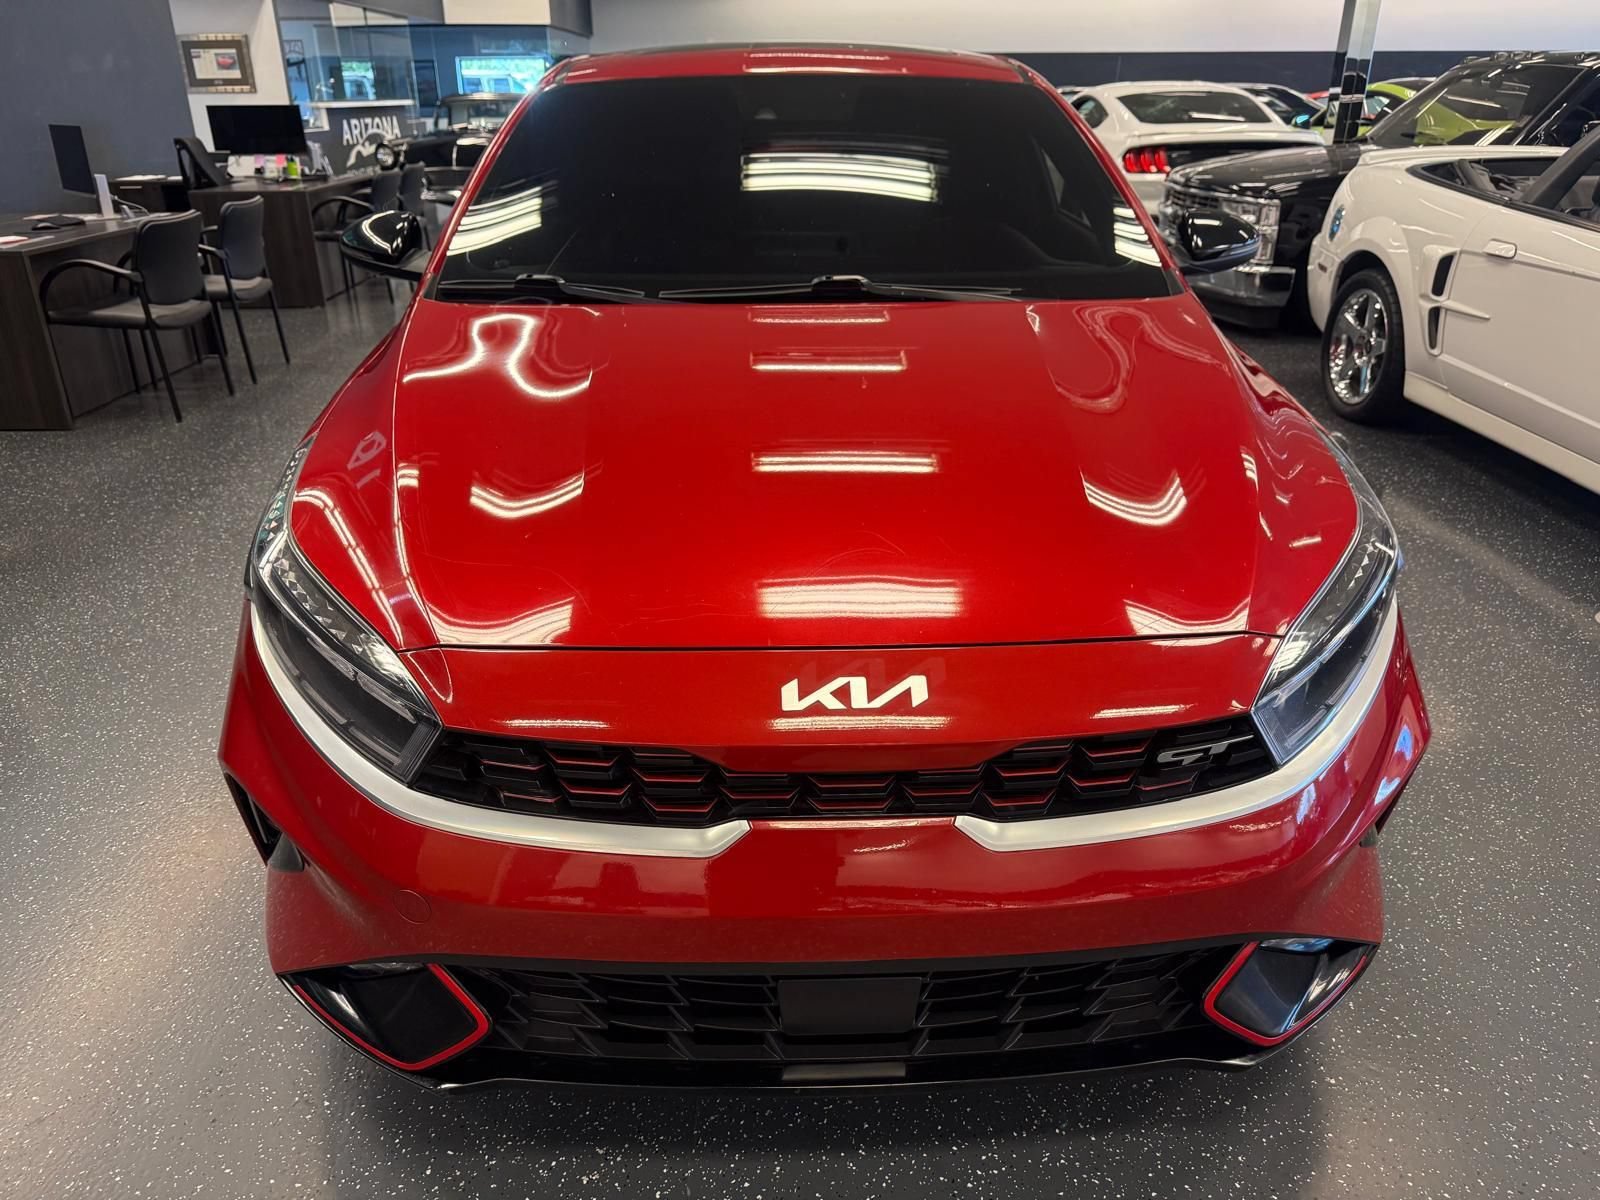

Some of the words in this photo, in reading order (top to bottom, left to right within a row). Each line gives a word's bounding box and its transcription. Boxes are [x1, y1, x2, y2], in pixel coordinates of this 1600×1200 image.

[342, 115, 401, 146] ARIZONA
[781, 675, 928, 711] KIA
[1157, 734, 1254, 766] GT
